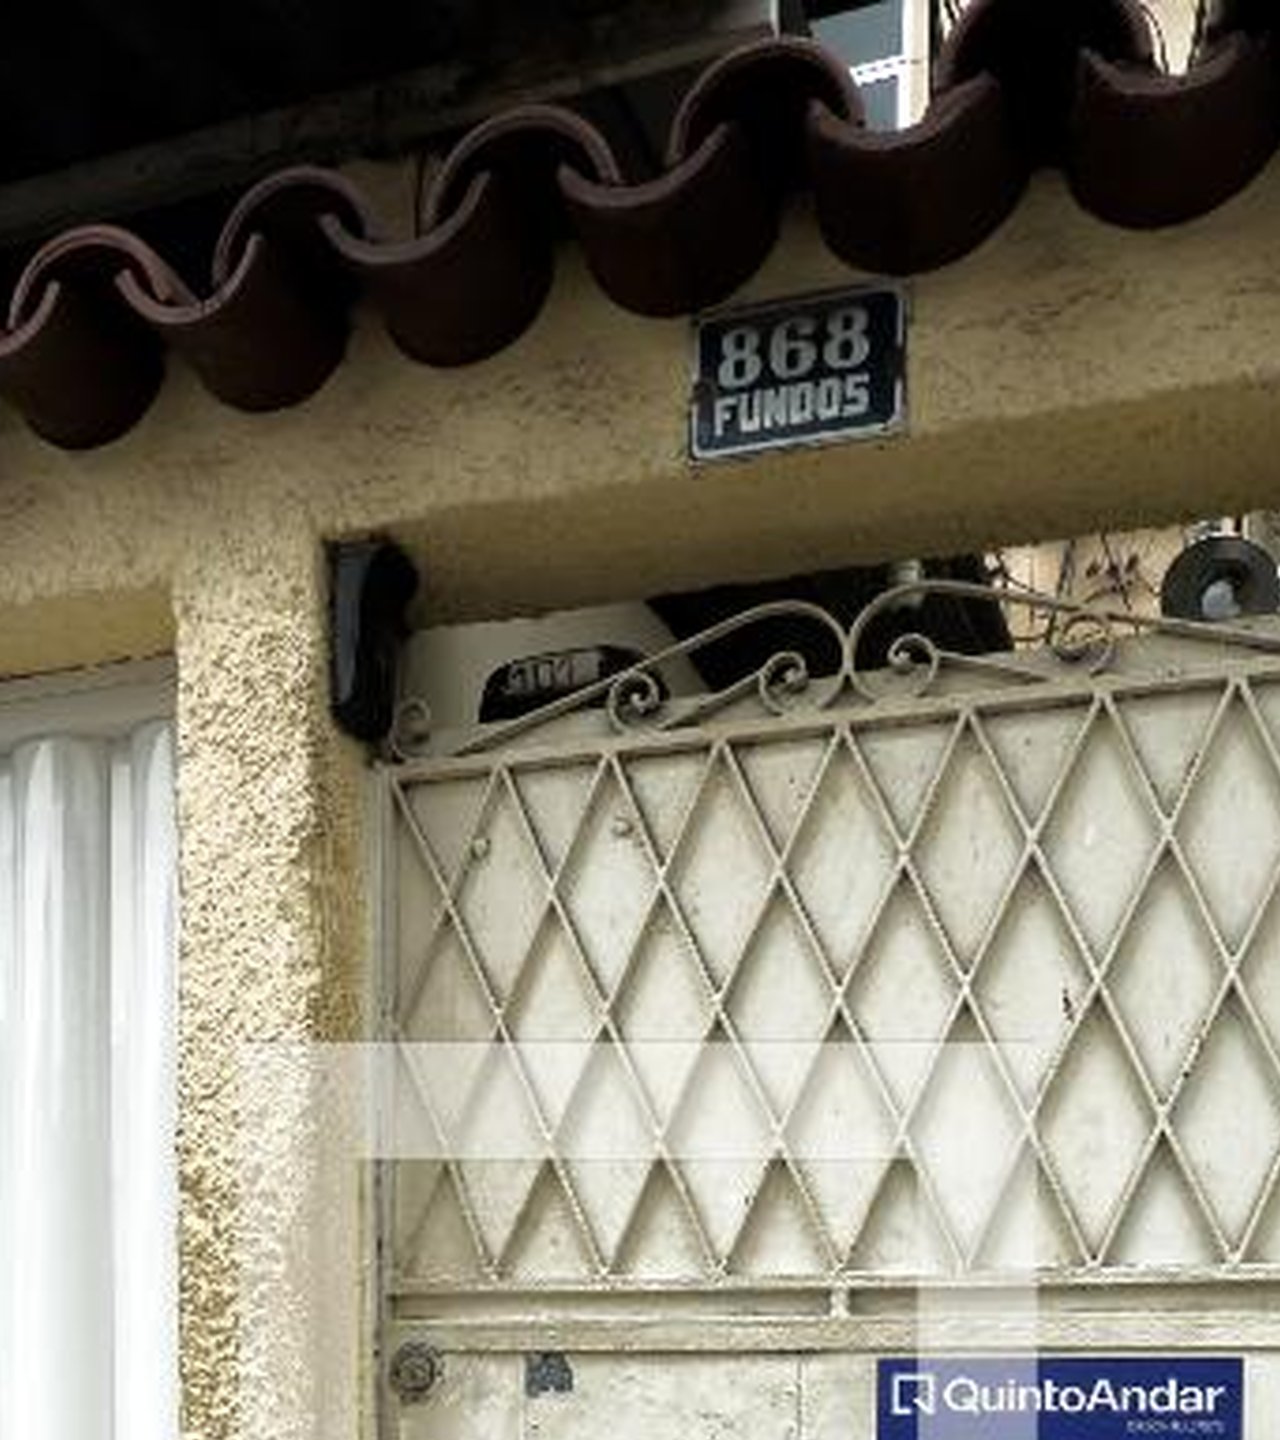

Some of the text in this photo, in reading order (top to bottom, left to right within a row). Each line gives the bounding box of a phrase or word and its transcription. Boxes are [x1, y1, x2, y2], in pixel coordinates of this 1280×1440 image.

[719, 306, 870, 390] 868
[714, 373, 870, 437] FUNDOS
[942, 1377, 1225, 1415] QuintoAndar
